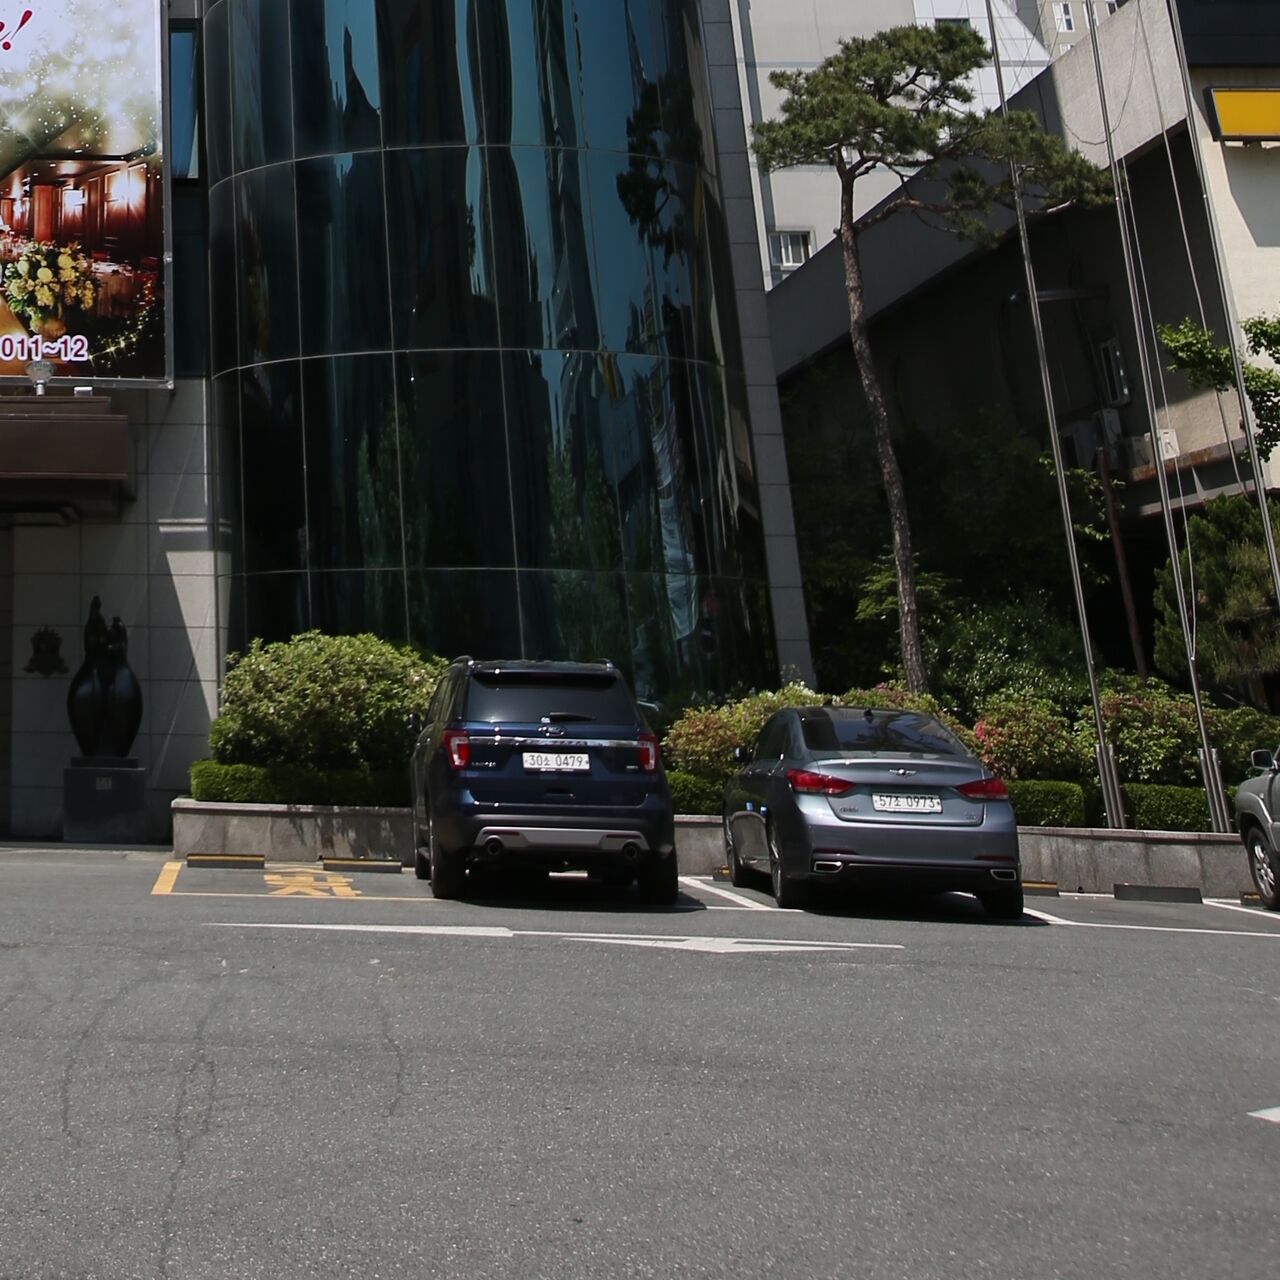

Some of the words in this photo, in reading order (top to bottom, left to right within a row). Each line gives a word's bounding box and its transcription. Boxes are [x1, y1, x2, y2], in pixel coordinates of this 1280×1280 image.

[528, 754, 551, 767] 30소
[555, 755, 583, 767] 0479
[906, 796, 936, 808] 0973
